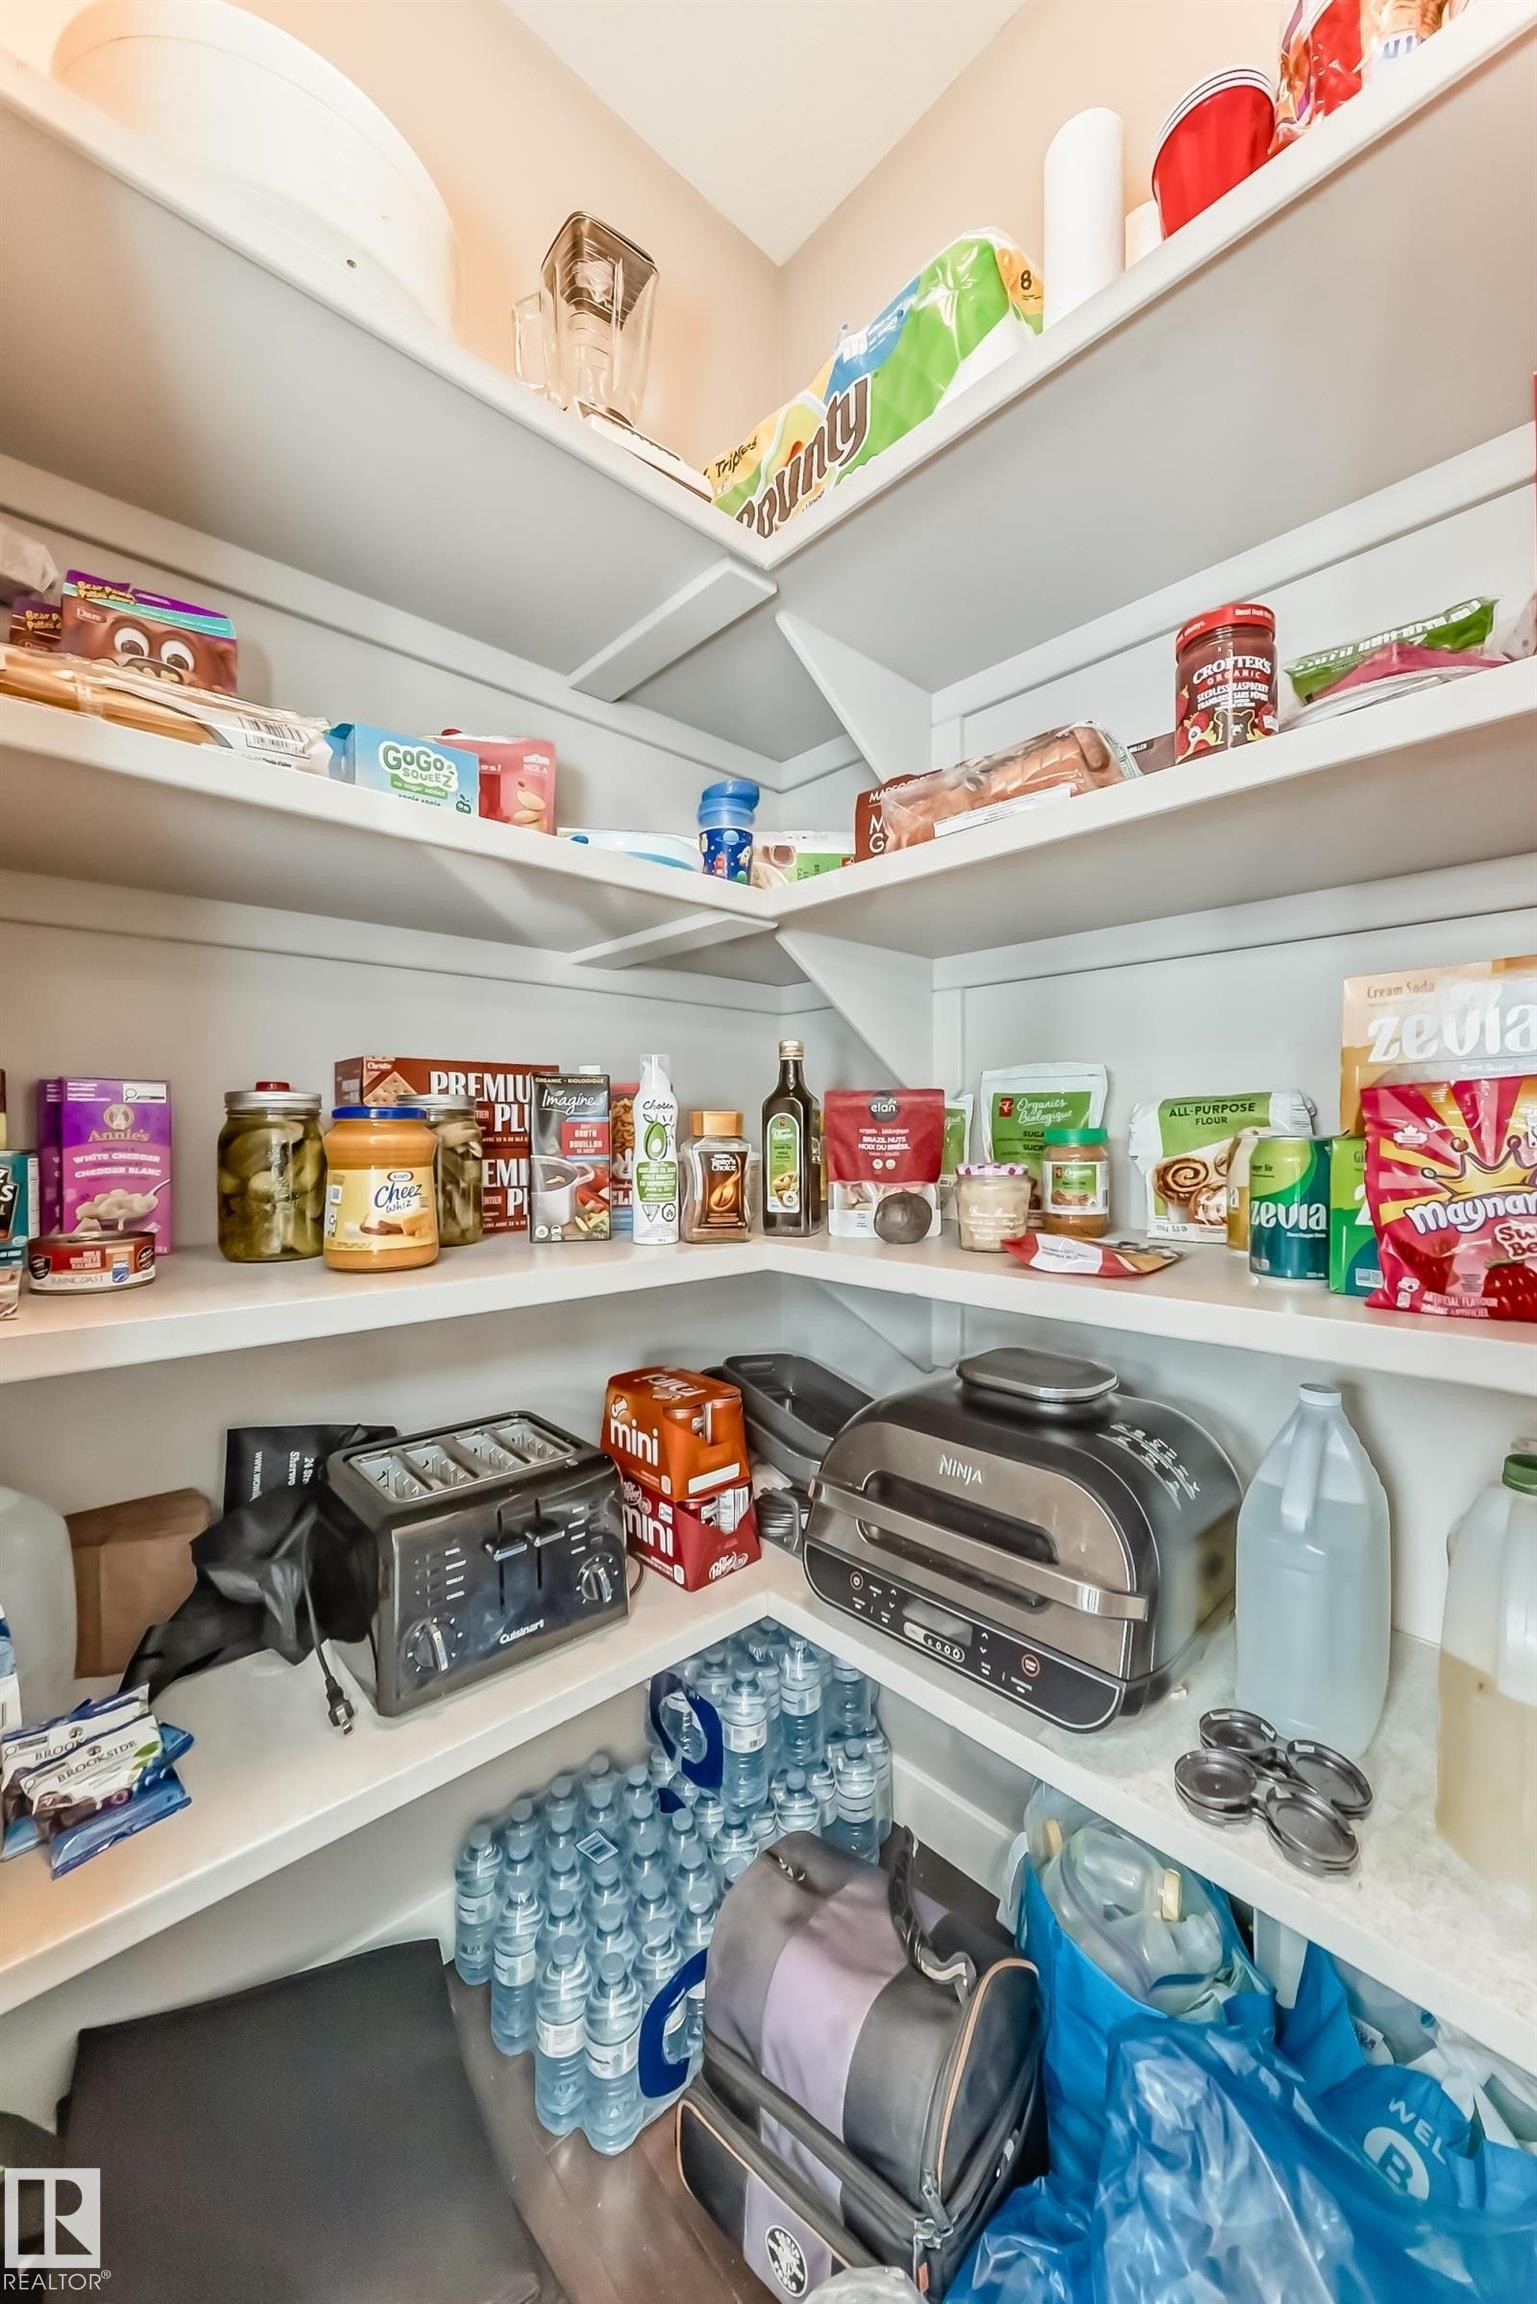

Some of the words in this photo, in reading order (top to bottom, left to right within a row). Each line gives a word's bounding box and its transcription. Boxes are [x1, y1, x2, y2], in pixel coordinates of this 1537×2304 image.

[1019, 269, 1034, 291] 8
[1206, 669, 1261, 686] ORGANIC
[1367, 984, 1403, 999] Cream
[1406, 979, 1435, 994] Soda
[429, 1070, 532, 1103] PREMIU
[541, 1088, 597, 1116] Imagine
[1016, 1096, 1068, 1117] Organics
[1169, 1102, 1257, 1118] ALL-PURPOSE
[494, 1103, 531, 1133] PL
[1195, 1116, 1229, 1126] FLOUR
[88, 1128, 151, 1143] Annie's
[574, 1129, 598, 1138] BROTH
[887, 1136, 907, 1144] NUTS
[1022, 1130, 1045, 1138] SUGA
[569, 1140, 603, 1149] BOUILLON
[1022, 1143, 1046, 1151] SUCR
[72, 1152, 110, 1164] WHITE
[373, 1182, 423, 1208] Cheez
[1250, 1200, 1329, 1231] zevia
[1404, 1191, 1537, 1236] Maynar
[609, 1417, 660, 1467] mini
[287, 1450, 300, 1487] Sherwo
[938, 1453, 985, 1486] NINJA
[499, 1618, 545, 1645] Cuisinart
[56, 1740, 139, 1784] BROOKSIDE
